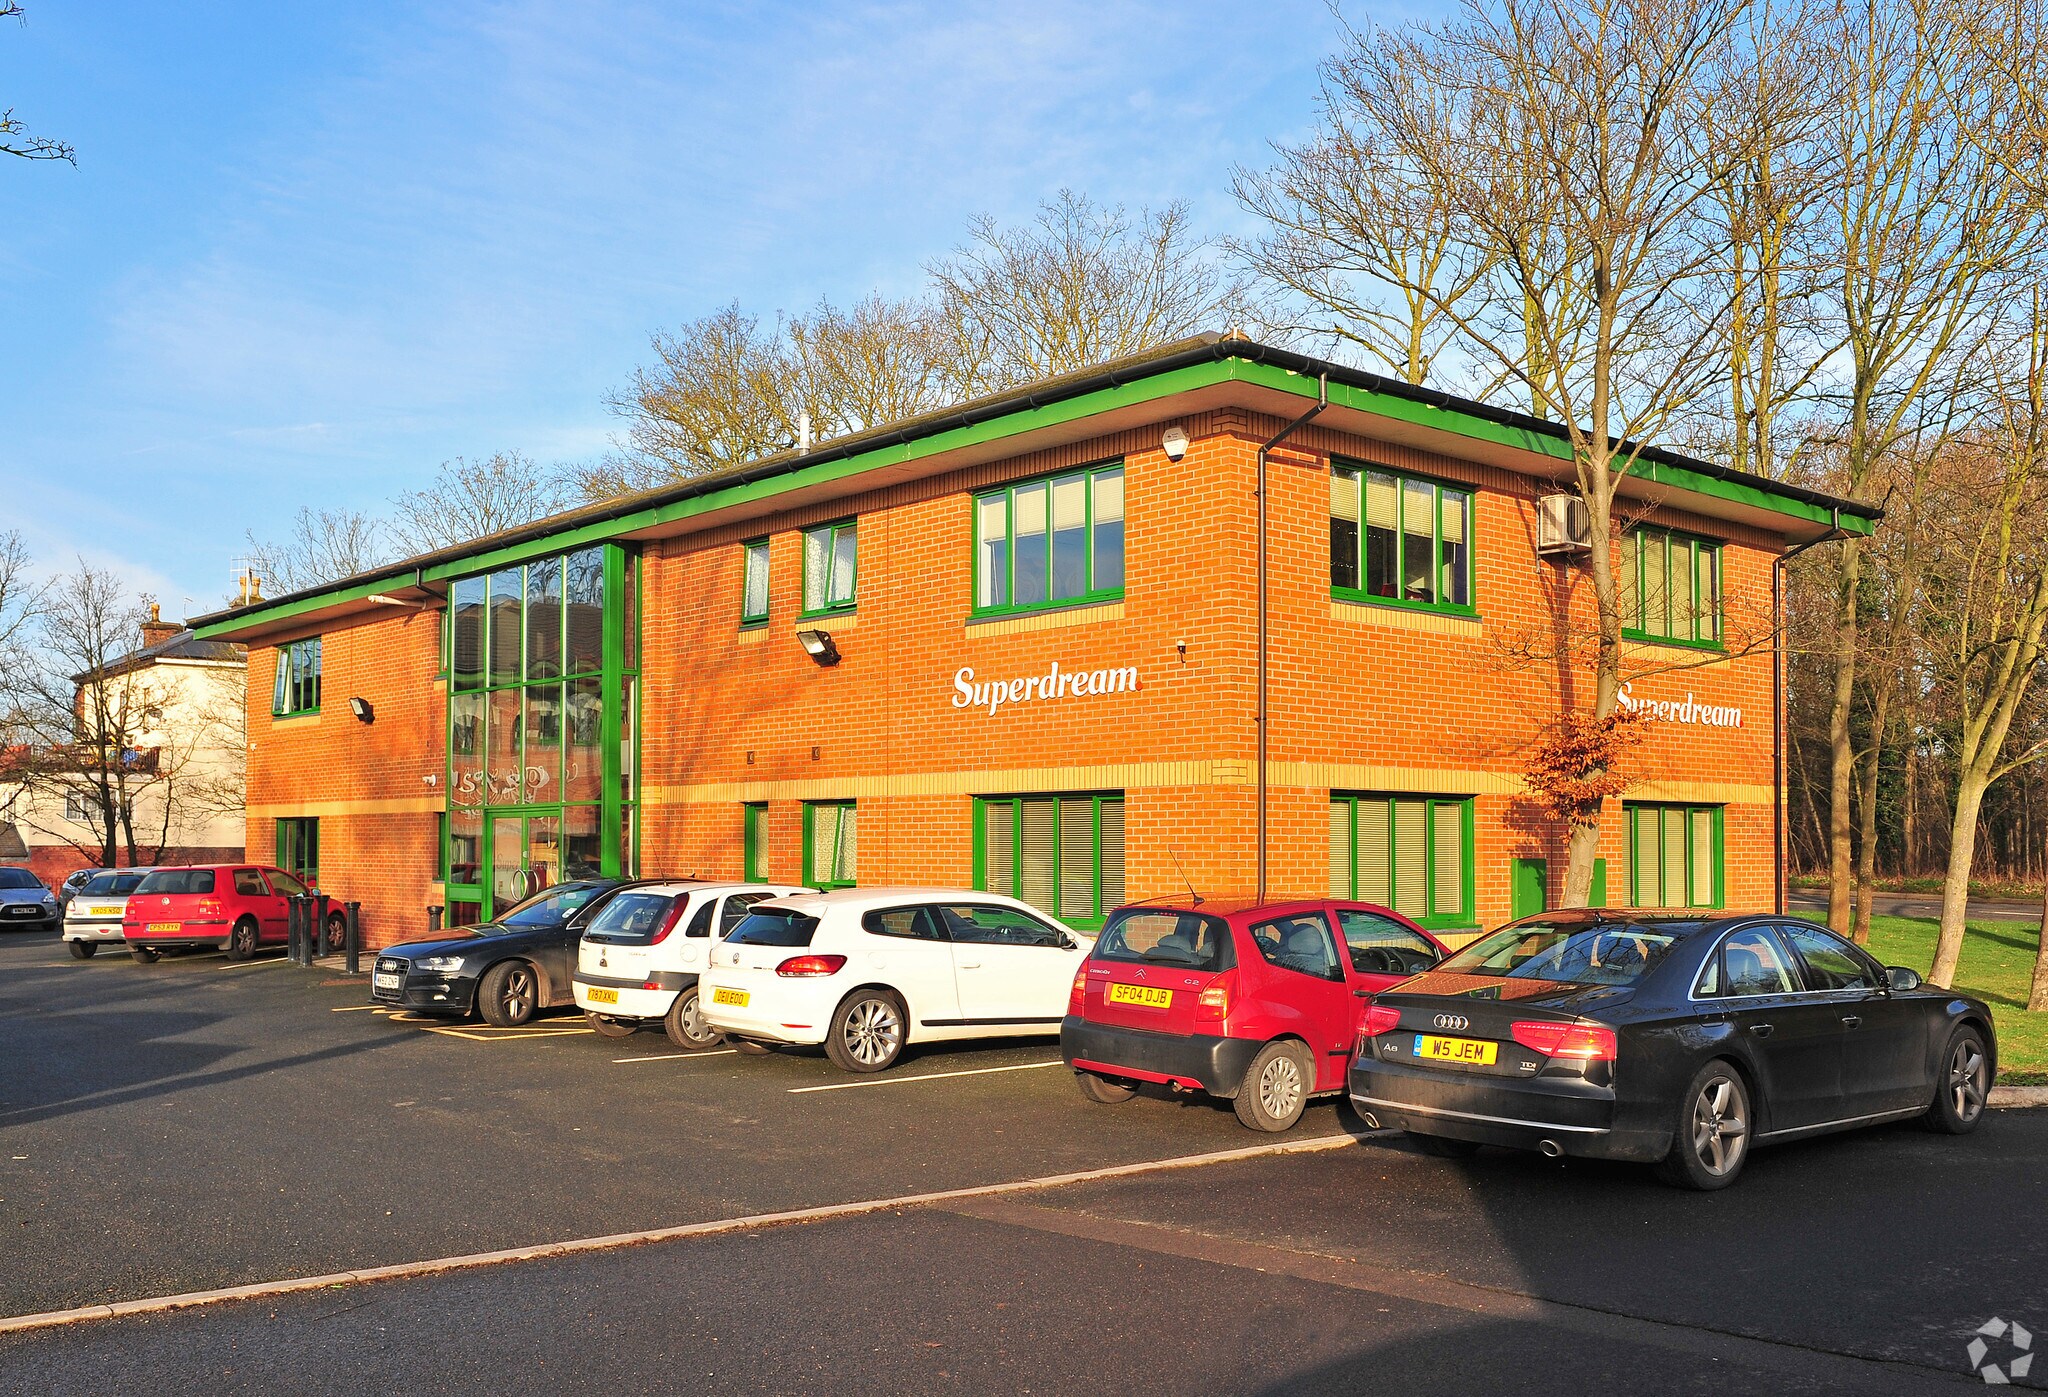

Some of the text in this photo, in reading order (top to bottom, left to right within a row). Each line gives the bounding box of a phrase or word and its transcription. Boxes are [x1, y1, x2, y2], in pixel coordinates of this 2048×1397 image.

[1116, 985, 1167, 1003] SF04 DJB
[1433, 1040, 1484, 1060] W5 JEM
